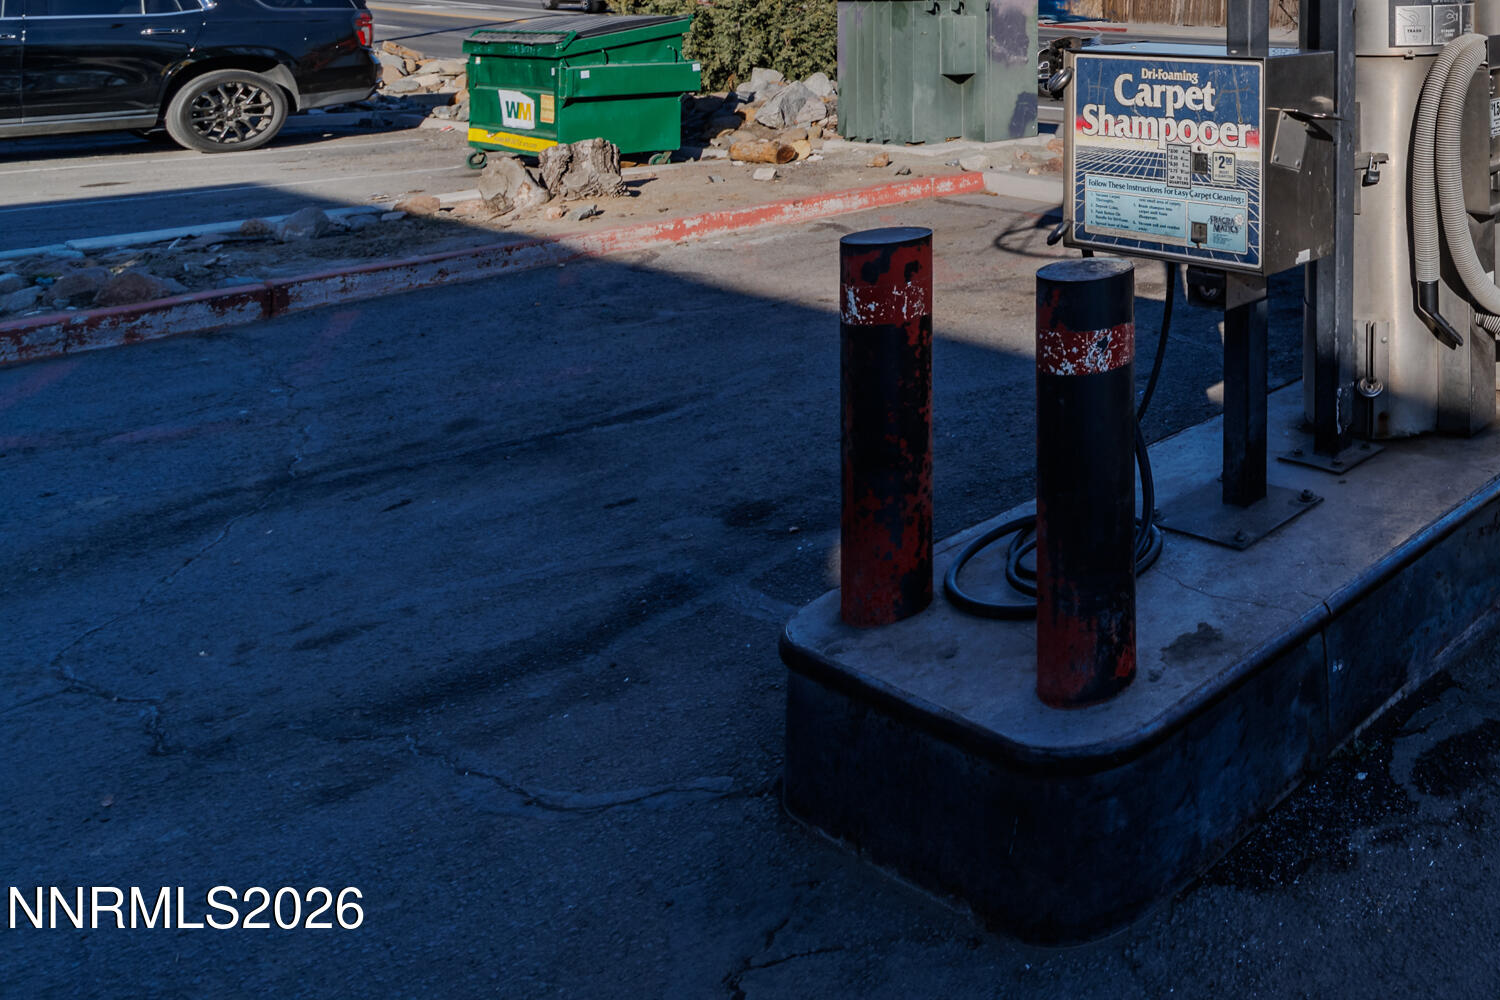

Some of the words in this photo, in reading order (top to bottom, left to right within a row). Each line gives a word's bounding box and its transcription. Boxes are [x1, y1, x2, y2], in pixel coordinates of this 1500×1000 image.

[505, 101, 532, 121] WM
[1114, 73, 1216, 118] Carpet
[1082, 103, 1252, 150] Shampooer
[1088, 178, 1107, 187] Follow
[1108, 180, 1126, 190] These
[1126, 183, 1163, 194] Instructions
[1174, 188, 1188, 198] Easy
[1189, 189, 1212, 200] Carpet
